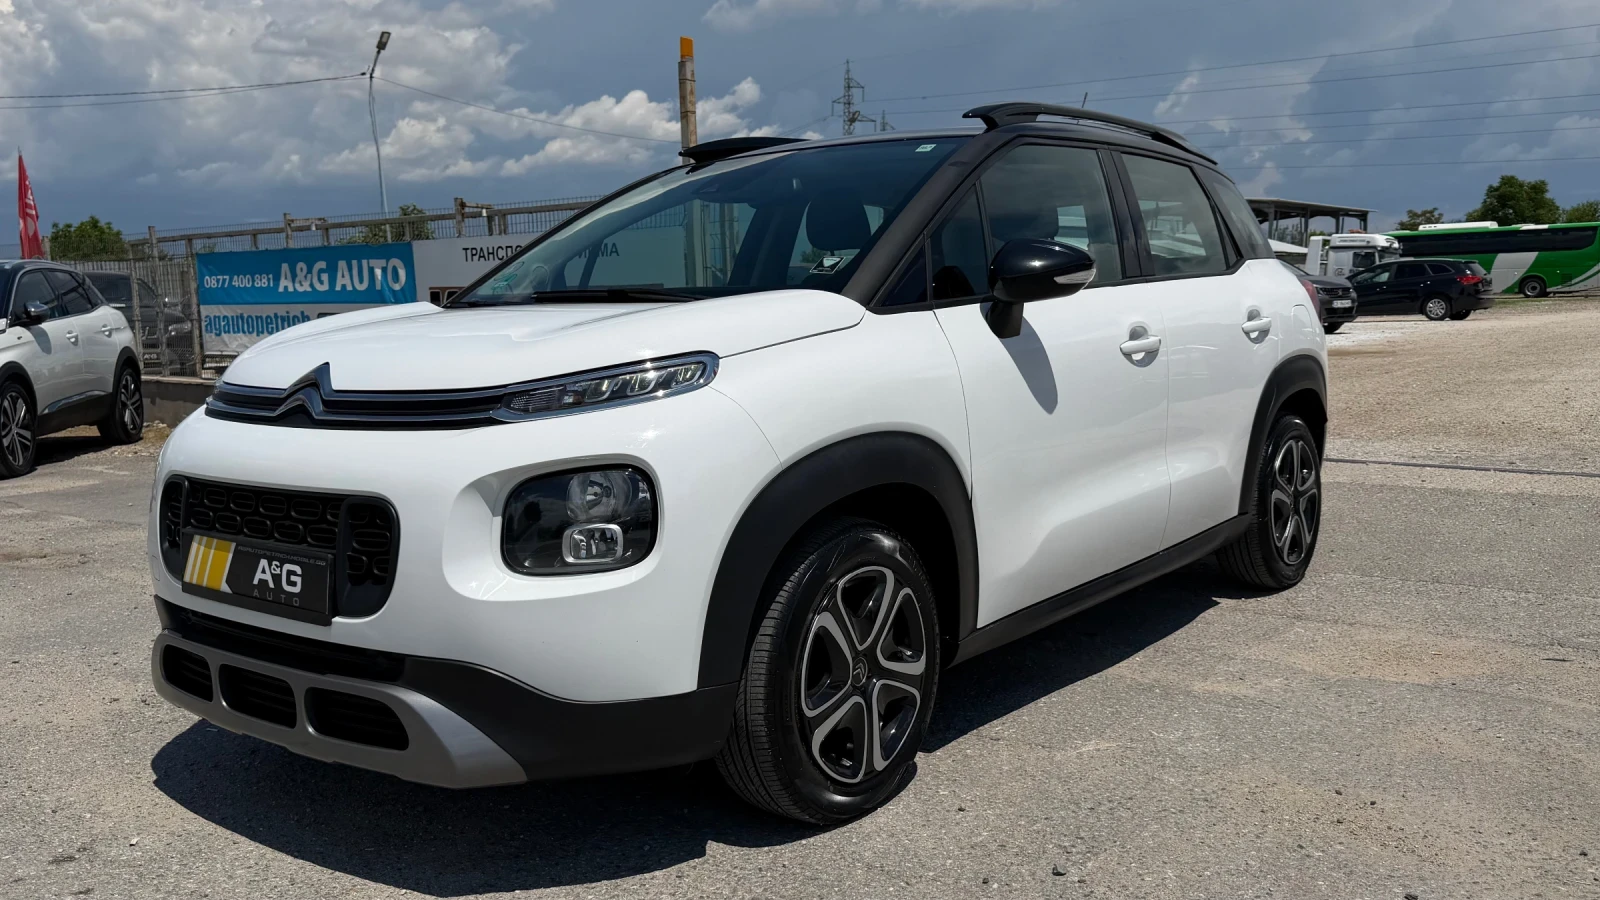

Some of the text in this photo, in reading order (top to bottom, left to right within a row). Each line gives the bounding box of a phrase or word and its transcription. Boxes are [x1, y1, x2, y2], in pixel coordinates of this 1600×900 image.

[204, 257, 407, 293] 0877 400 881 A&G AUTO
[252, 558, 303, 594] A&G
[252, 588, 300, 607] AUTO
